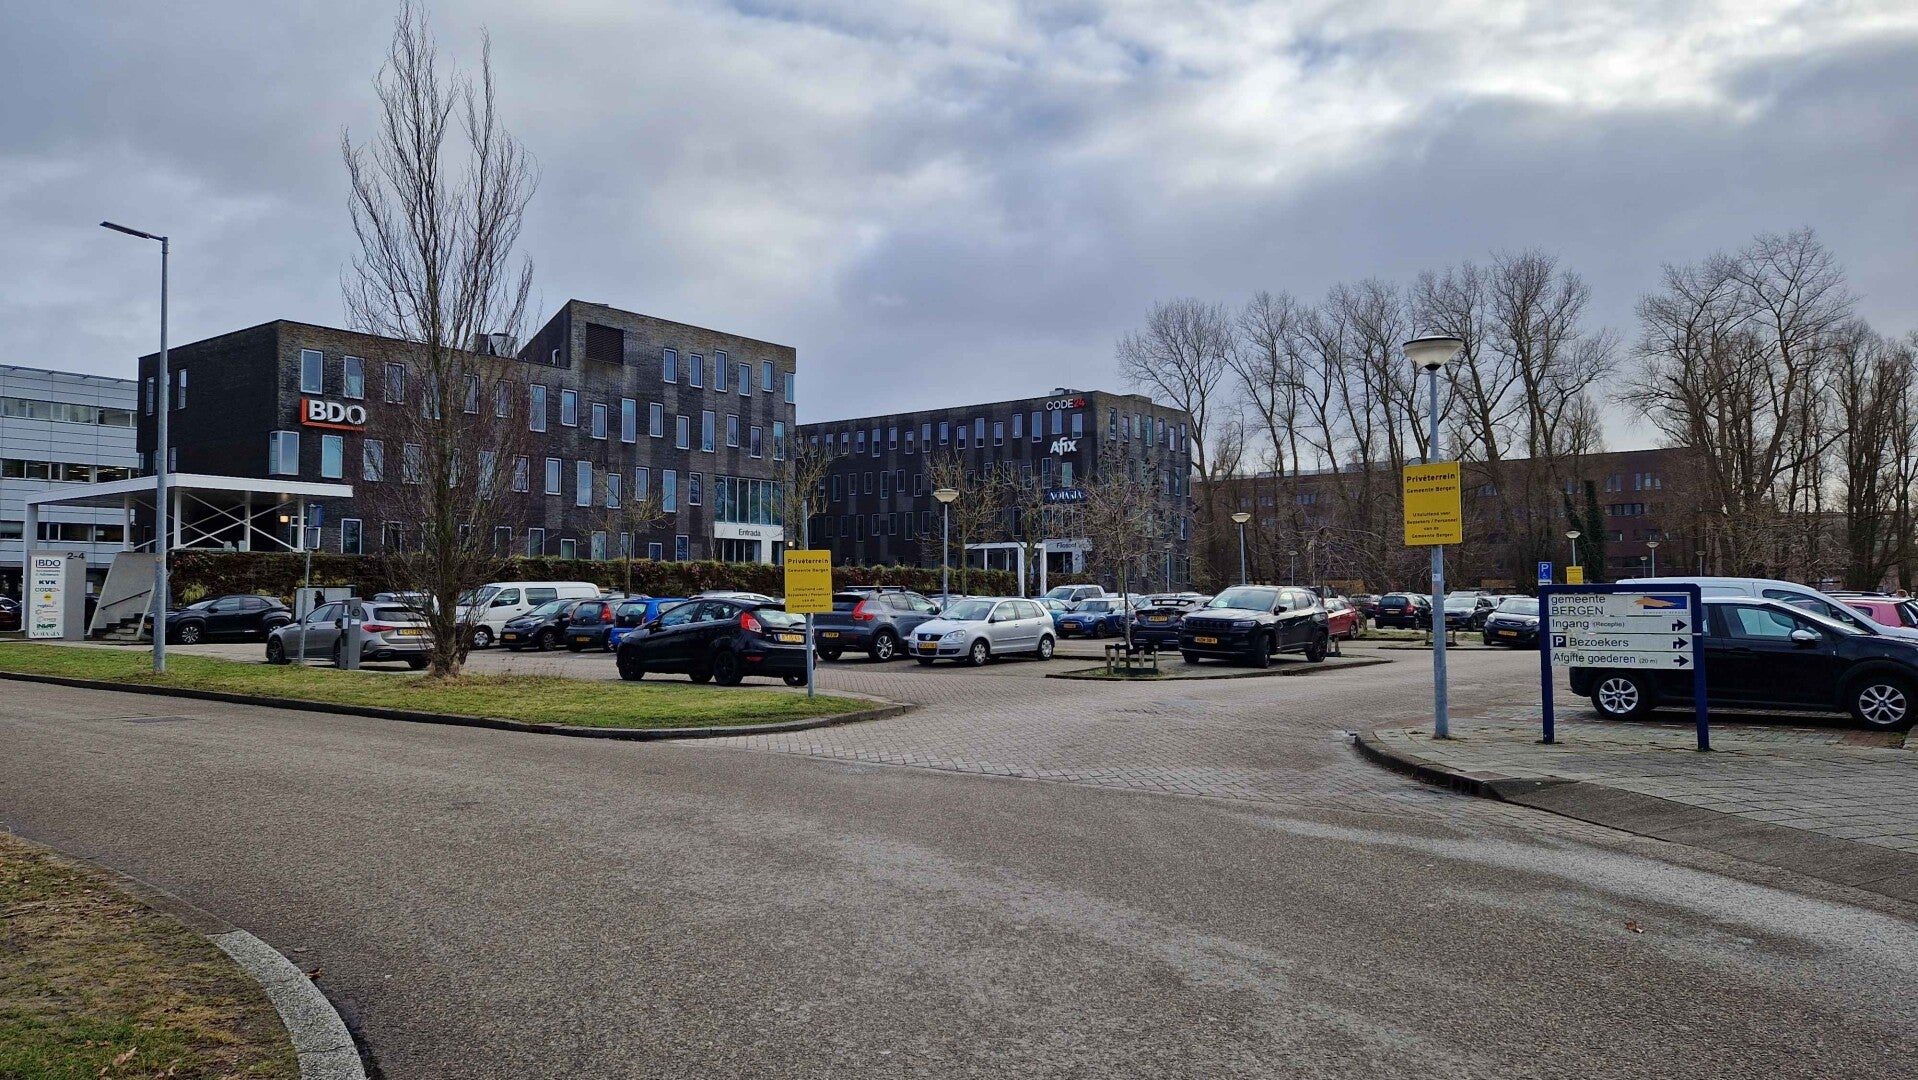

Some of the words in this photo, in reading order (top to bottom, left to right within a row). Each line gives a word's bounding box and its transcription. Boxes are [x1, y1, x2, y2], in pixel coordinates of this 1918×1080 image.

[1046, 399, 1086, 411] CODE24
[309, 399, 366, 425] BDO
[1050, 437, 1077, 456] Afix
[1406, 473, 1456, 483] Privéterrein
[738, 528, 761, 537] Entrada
[67, 552, 86, 560] 2-4
[38, 559, 61, 567] BDO
[1551, 594, 1606, 605] gemeente
[1551, 605, 1604, 615] BERGEN
[1552, 618, 1589, 630] Ingang
[1569, 637, 1629, 648] Bezoekers
[1553, 652, 1585, 663] Afgifte
[1587, 653, 1636, 664] goederen
